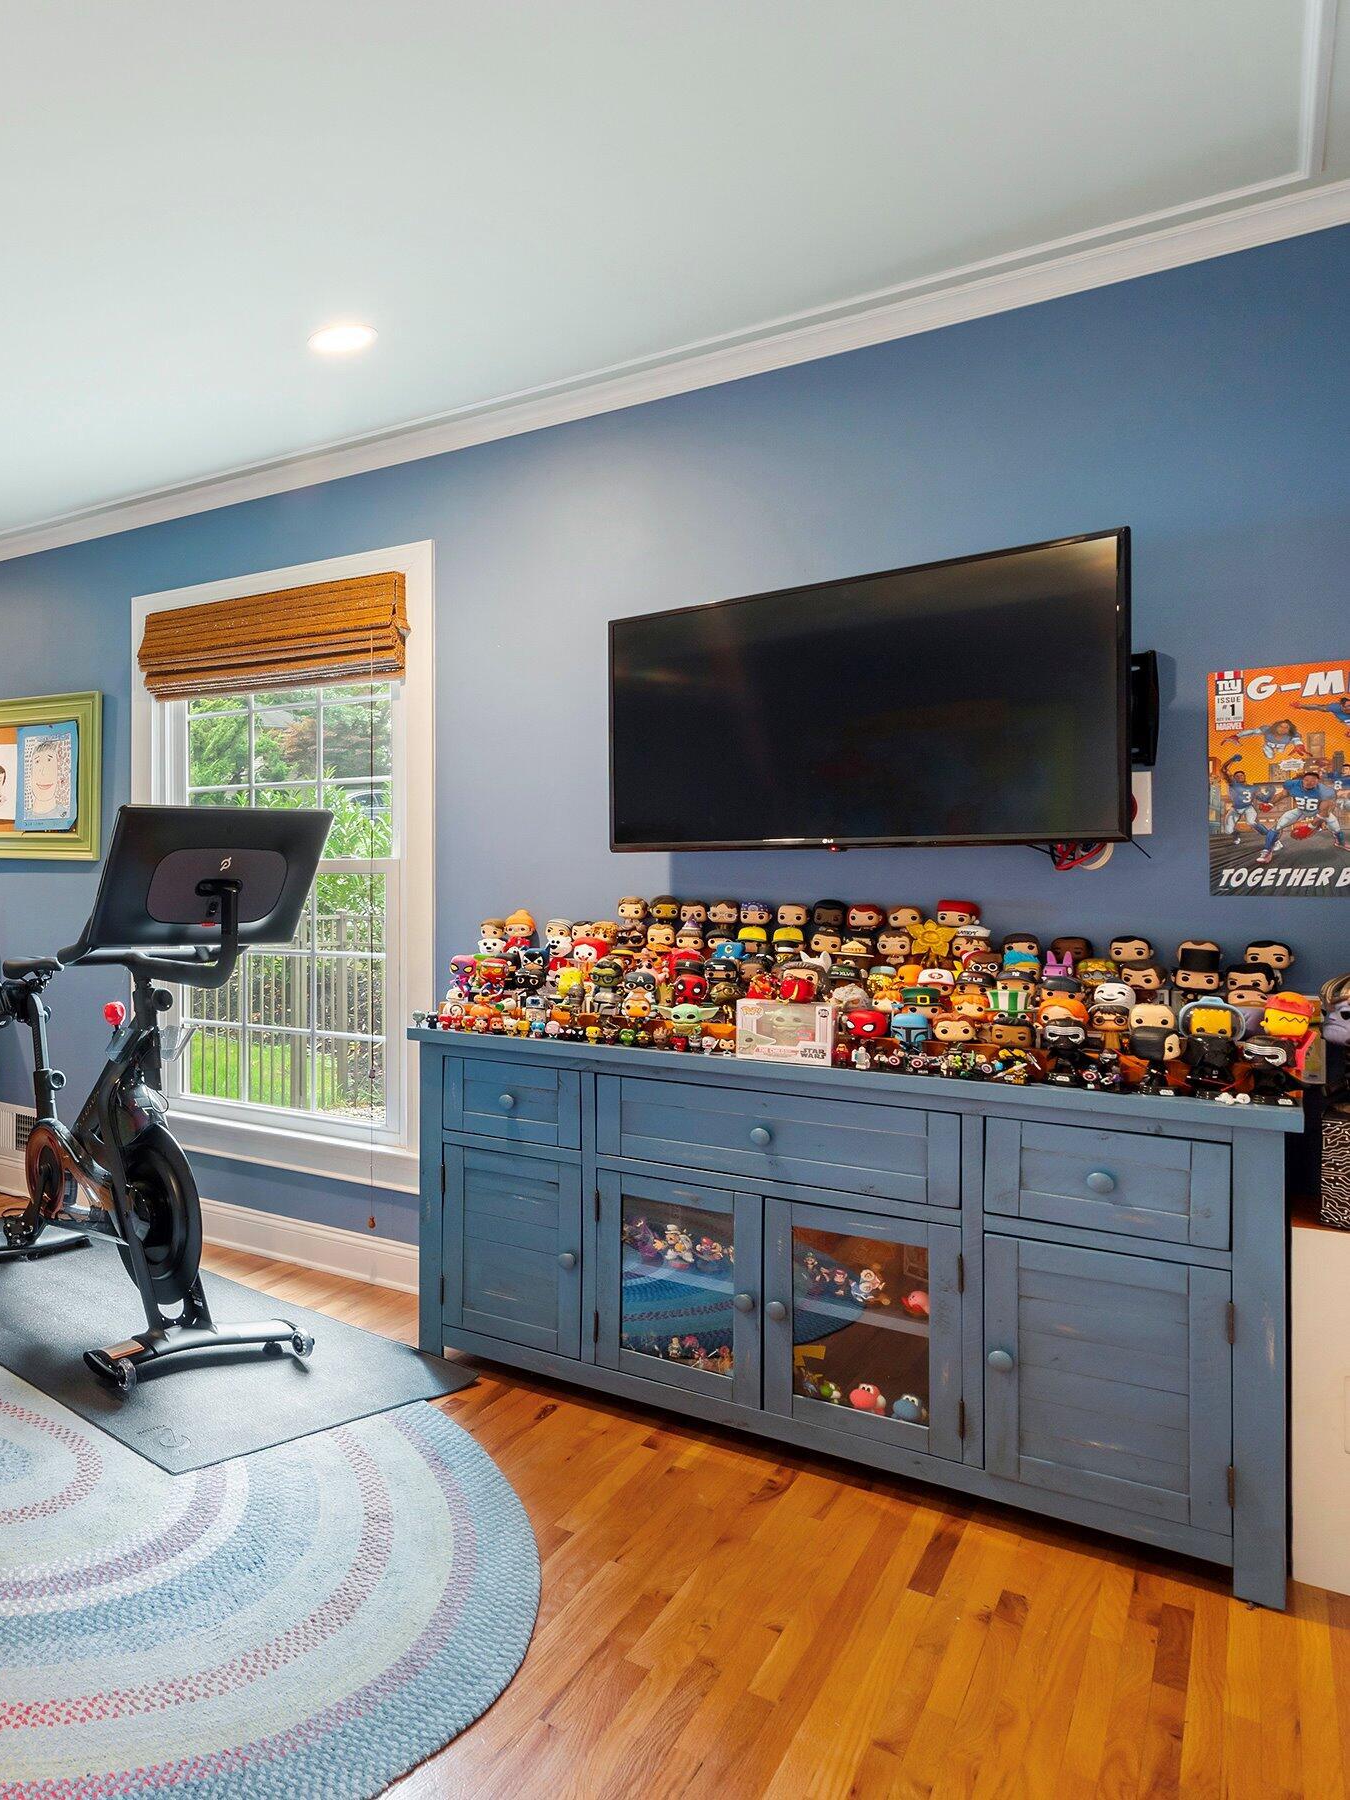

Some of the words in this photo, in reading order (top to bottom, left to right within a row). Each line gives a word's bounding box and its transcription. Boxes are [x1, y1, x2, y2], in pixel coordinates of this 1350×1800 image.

[1246, 669, 1350, 701] G-M
[1217, 696, 1241, 704] ISSUE
[1242, 790, 1252, 803] 3
[1295, 797, 1319, 811] 26
[1218, 867, 1335, 888] TOGETHER
[724, 944, 733, 954] C
[636, 975, 645, 983] A
